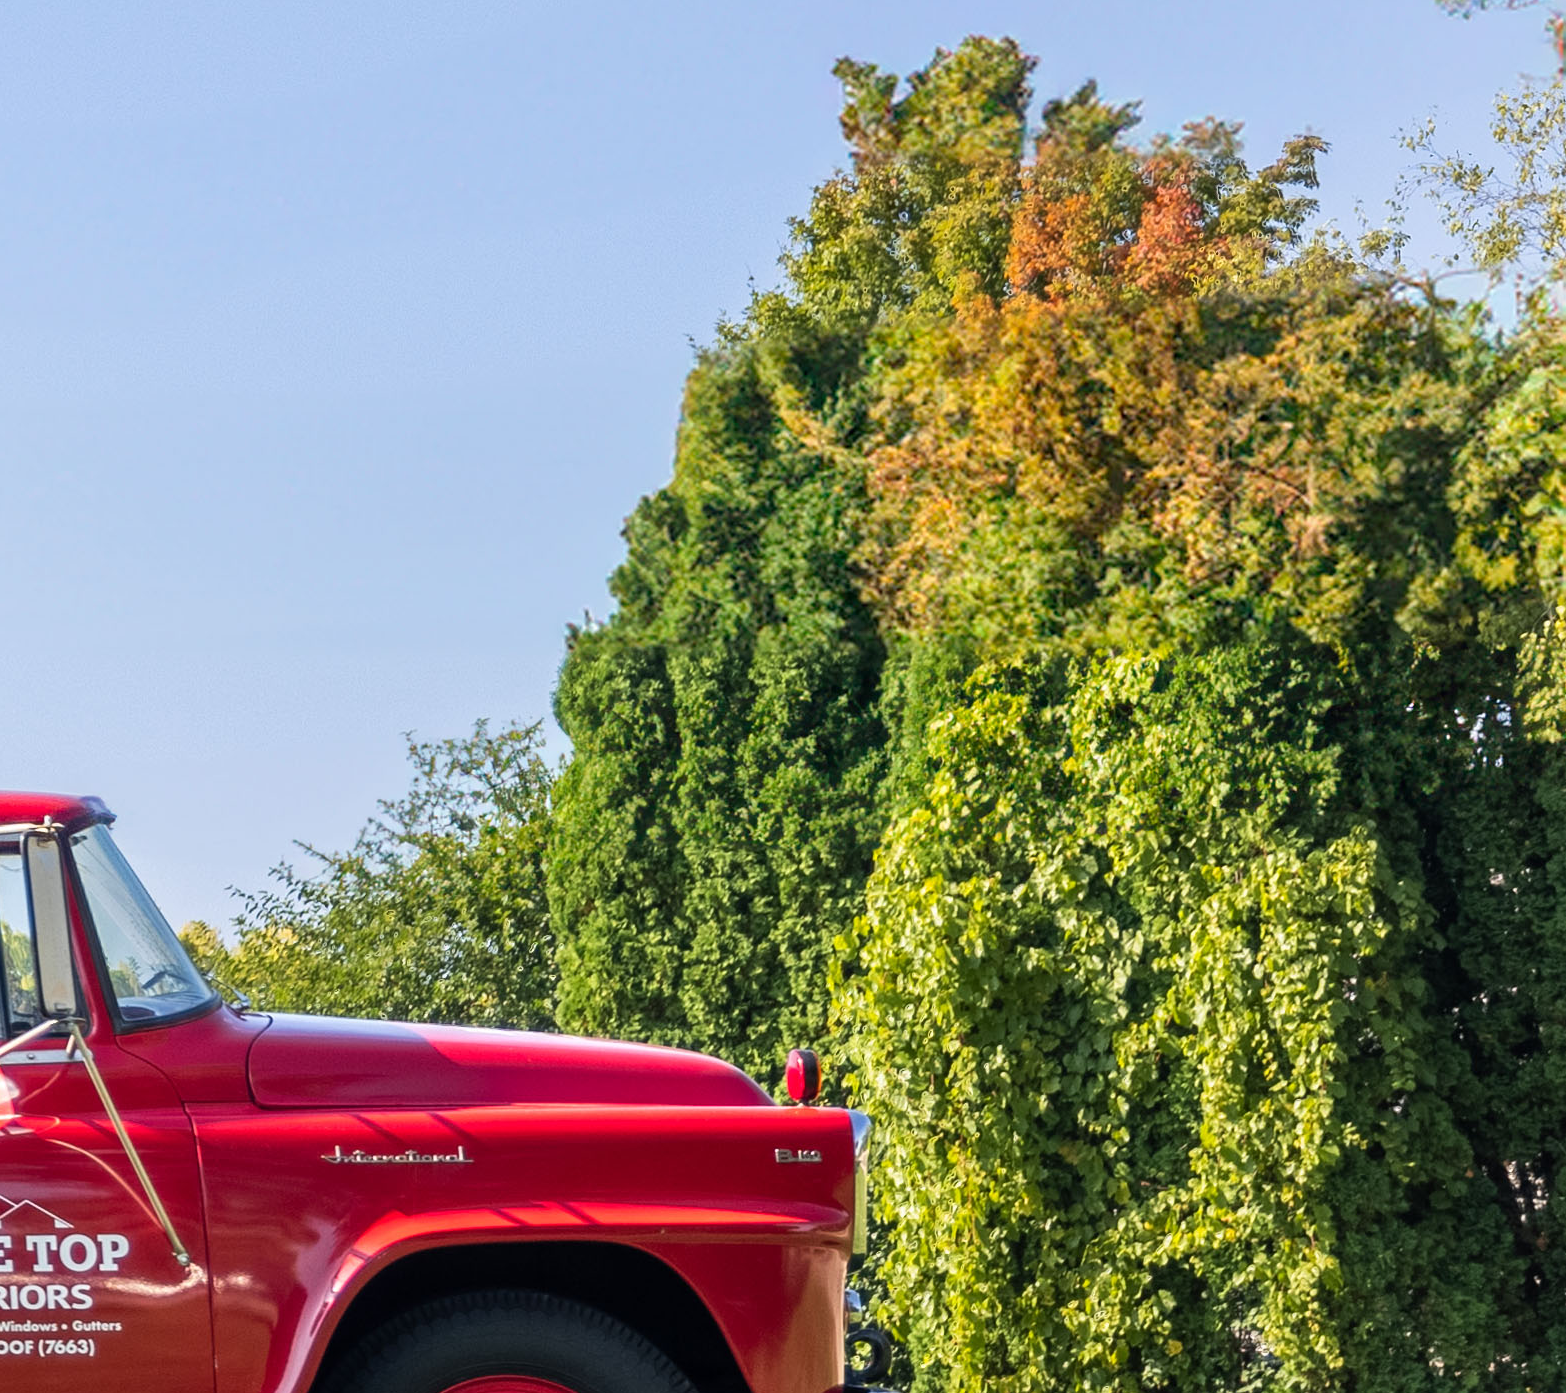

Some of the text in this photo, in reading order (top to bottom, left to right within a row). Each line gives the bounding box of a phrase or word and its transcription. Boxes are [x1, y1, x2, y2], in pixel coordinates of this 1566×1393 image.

[321, 1145, 474, 1164] International
[26, 1234, 129, 1272] TOP
[72, 1320, 122, 1331] Gutters
[39, 1339, 94, 1357] (7663)
